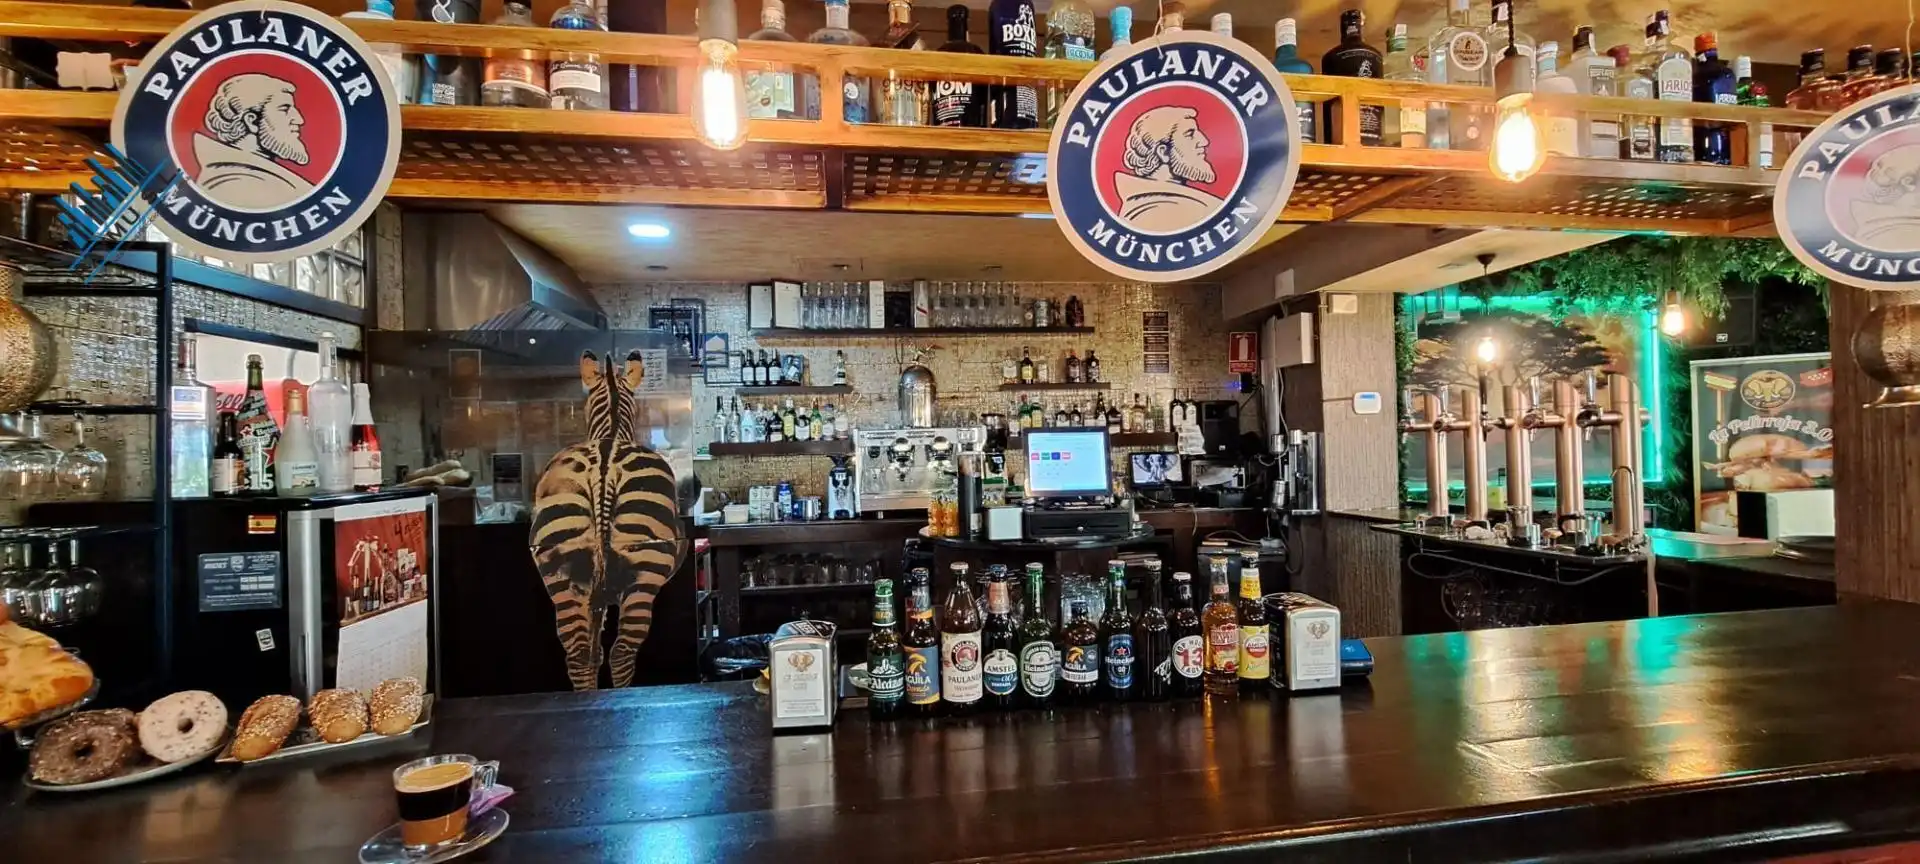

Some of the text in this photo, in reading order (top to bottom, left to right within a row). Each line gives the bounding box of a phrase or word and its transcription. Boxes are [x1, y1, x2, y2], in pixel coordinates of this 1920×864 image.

[145, 17, 373, 106] PAULANER
[1067, 49, 1269, 148] PAULANER
[157, 184, 352, 244] MÜNCHEN
[1088, 197, 1259, 263] MÜNCHEN
[1177, 648, 1203, 666] 13
